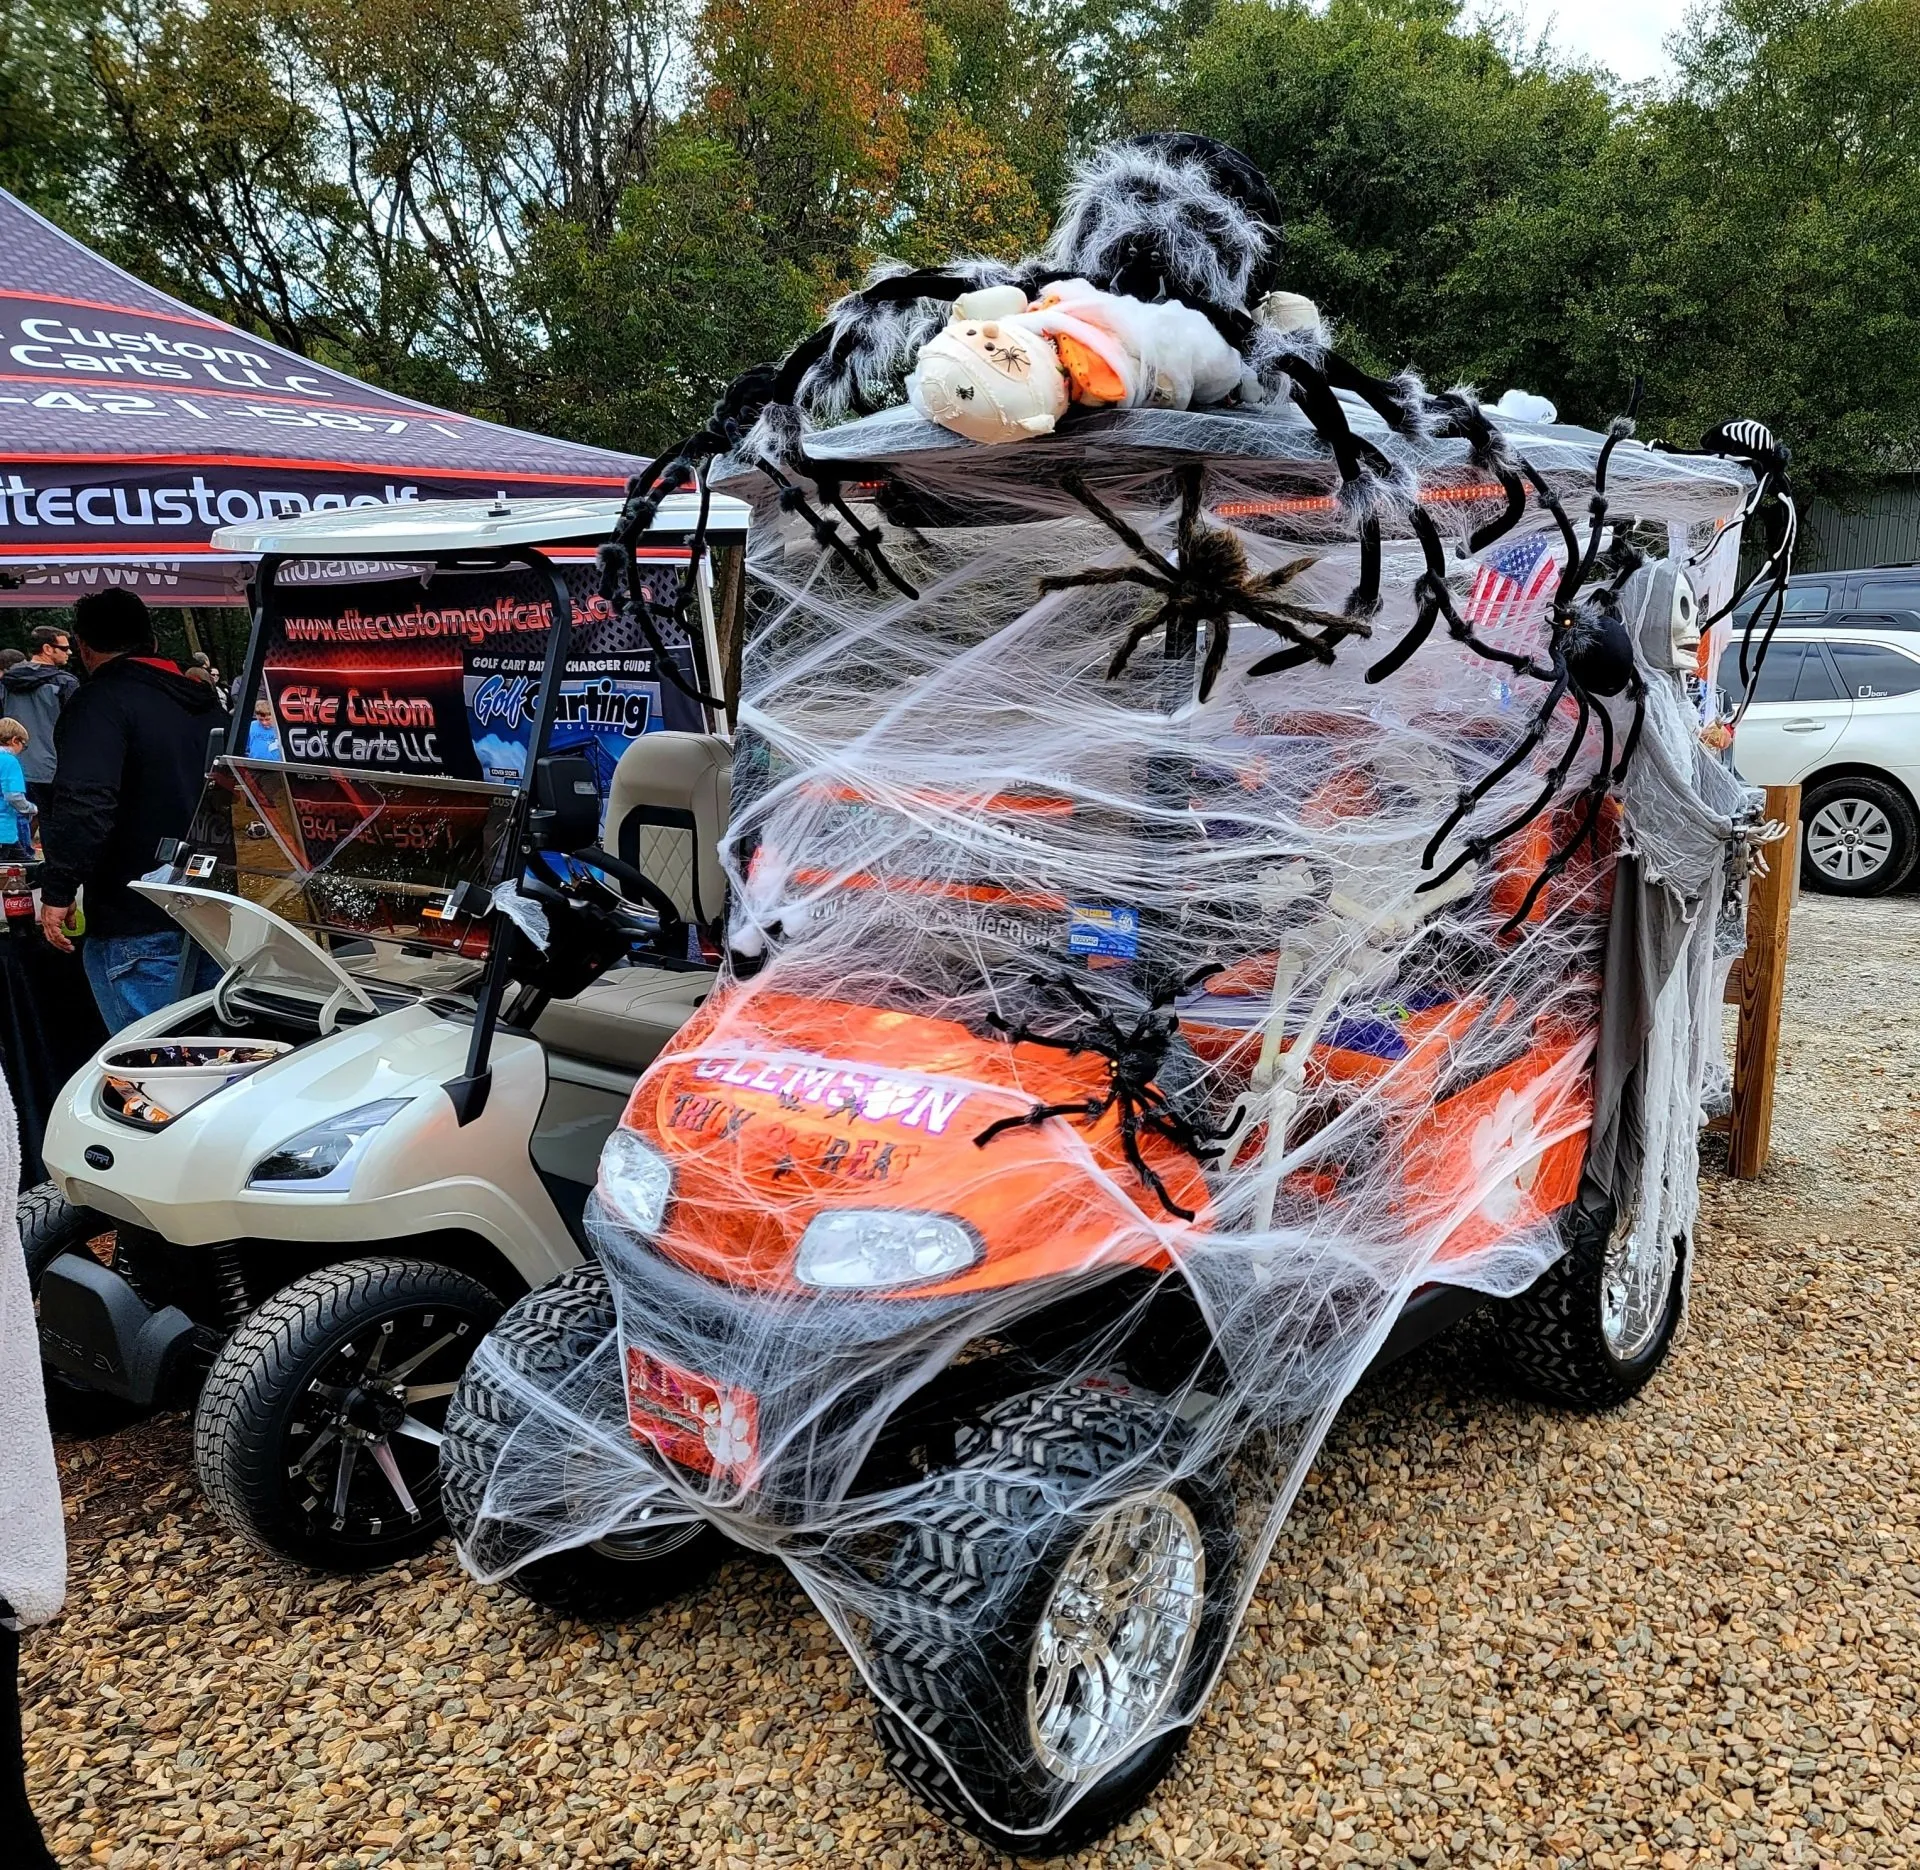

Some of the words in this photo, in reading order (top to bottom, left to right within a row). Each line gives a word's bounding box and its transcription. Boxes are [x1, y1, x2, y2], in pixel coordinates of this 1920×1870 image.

[20, 318, 272, 370] Custom
[9, 345, 193, 381] Carts
[201, 362, 334, 398] LLC
[472, 656, 498, 669] GOLF
[501, 659, 526, 671] CART
[565, 659, 621, 673] CHARGER
[623, 660, 652, 673] GUIDE
[346, 688, 436, 728] Custom
[473, 674, 528, 730] Golf
[288, 728, 331, 759] Gof
[333, 730, 399, 761] Carts
[400, 732, 443, 764] LLC
[553, 724, 619, 733] AGAZINE
[85, 1149, 110, 1165] STAR
